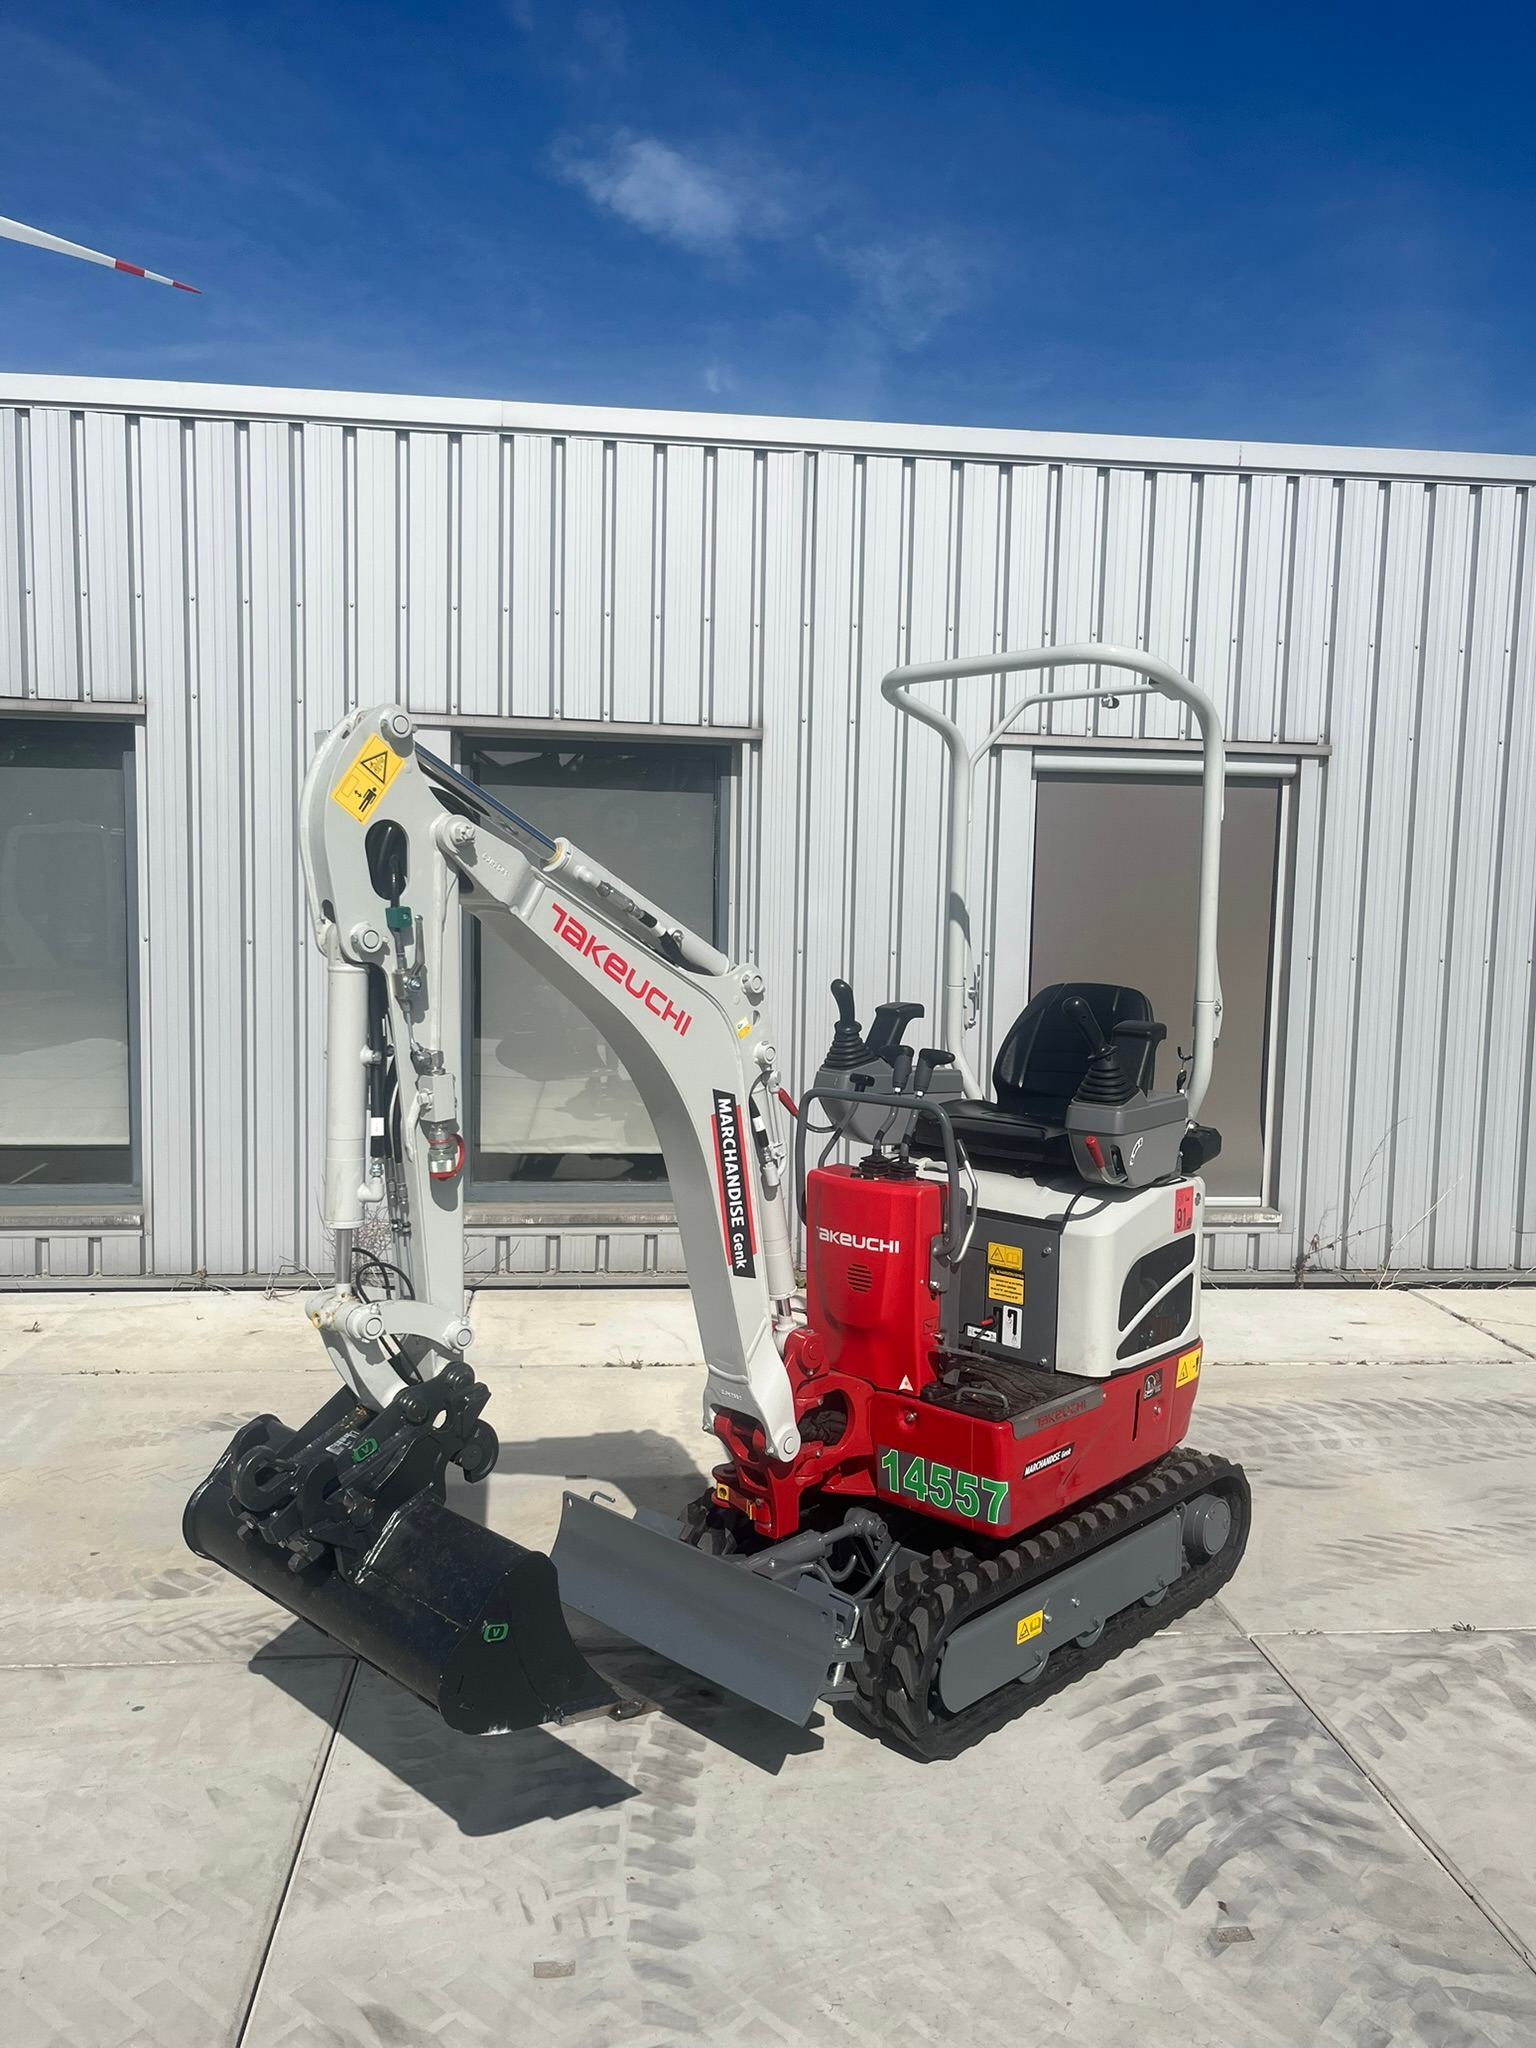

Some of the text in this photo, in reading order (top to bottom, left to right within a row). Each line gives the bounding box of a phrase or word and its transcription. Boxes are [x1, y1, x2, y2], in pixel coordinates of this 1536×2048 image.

[718, 1098, 747, 1269] MARCHANDISE Genk
[816, 1226, 900, 1254] AKEUCHI
[881, 1449, 1009, 1524] 14557
